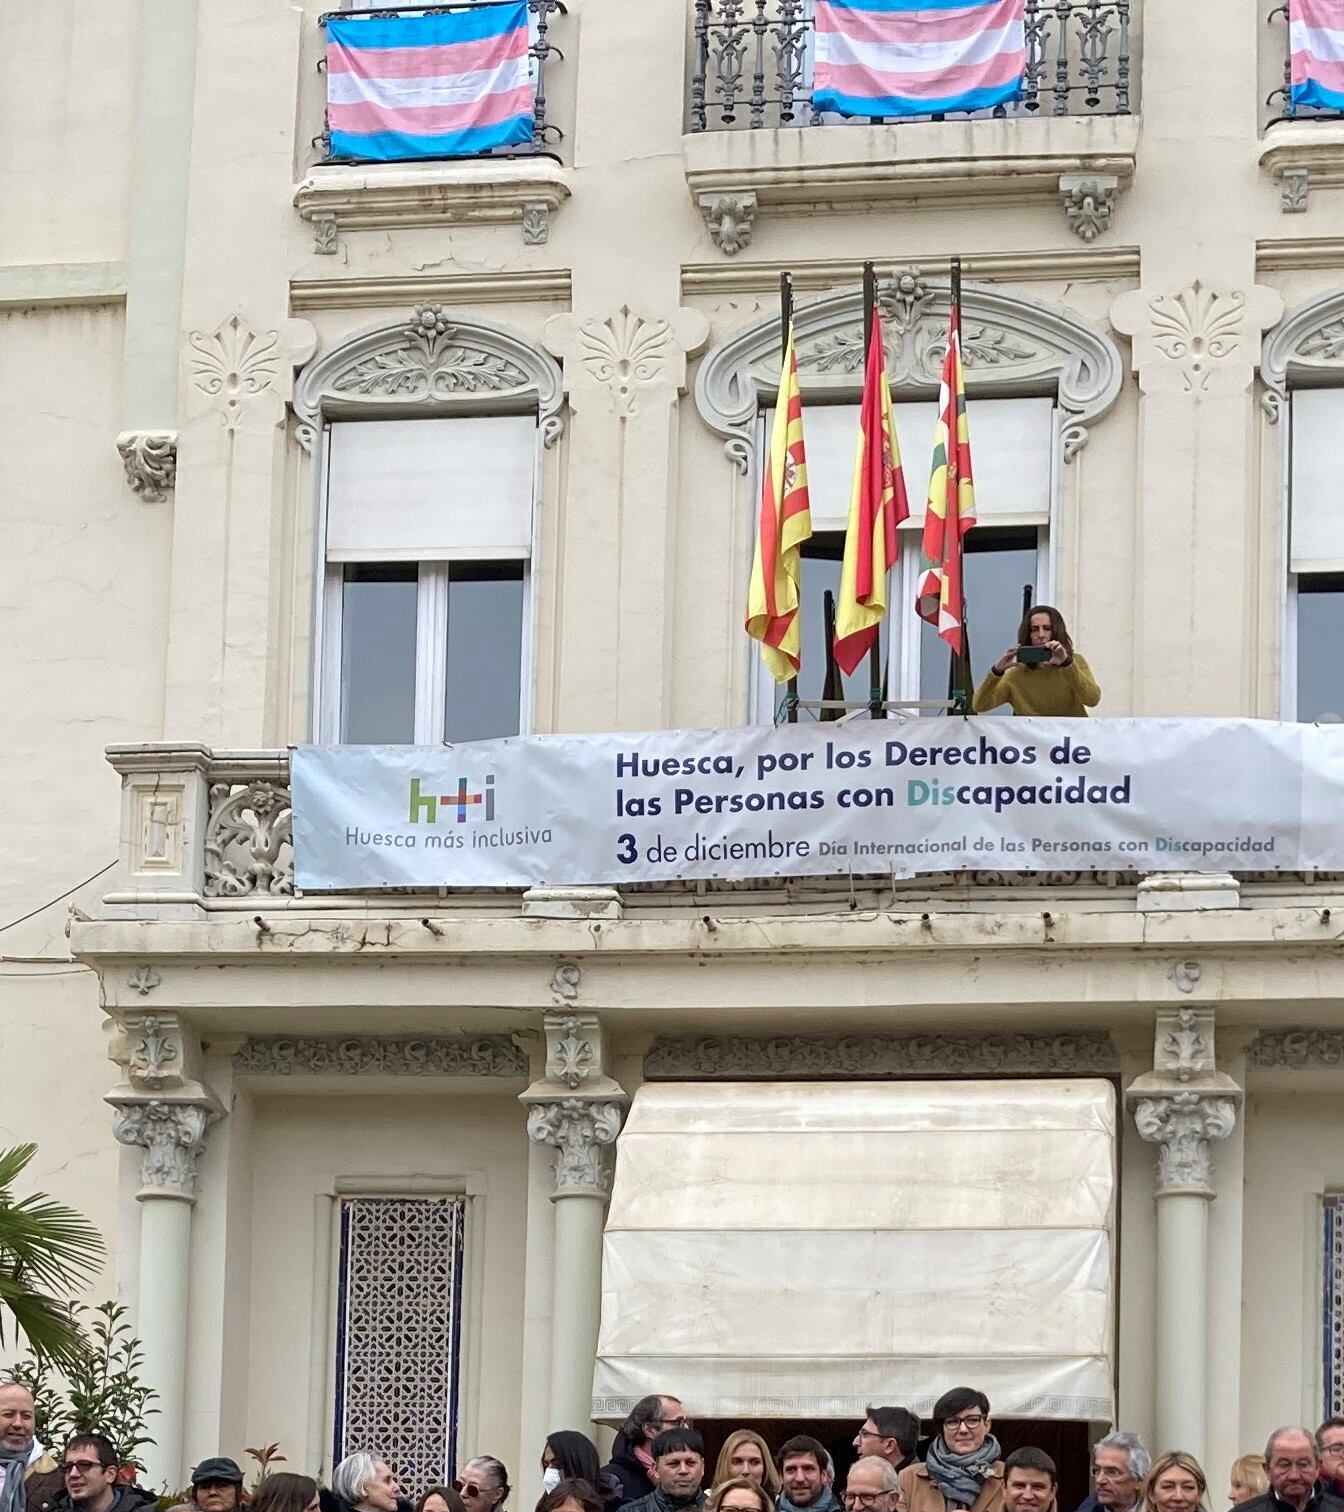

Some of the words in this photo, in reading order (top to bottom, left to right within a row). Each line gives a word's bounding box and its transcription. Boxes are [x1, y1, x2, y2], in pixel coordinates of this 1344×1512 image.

[616, 752, 745, 779] Huesca,
[757, 752, 815, 781] por
[826, 742, 872, 770] los
[885, 736, 1037, 767] Derechos
[1050, 736, 1091, 765] de
[616, 788, 662, 817] las
[674, 788, 825, 815] Personas
[837, 787, 894, 808] con
[907, 775, 1131, 814] Discapacidad
[346, 826, 416, 848] Huesca
[424, 830, 464, 849] más
[472, 826, 552, 848] inclusiva
[616, 833, 638, 864] 3
[646, 834, 678, 863] de
[684, 830, 810, 861] diciembre
[819, 839, 848, 856] Día
[854, 836, 967, 856] Internacional
[973, 836, 995, 851] de
[1001, 837, 1025, 852] las
[1032, 838, 1112, 853] Personas
[1118, 840, 1149, 852] con
[1154, 836, 1275, 856] Discapacidad
